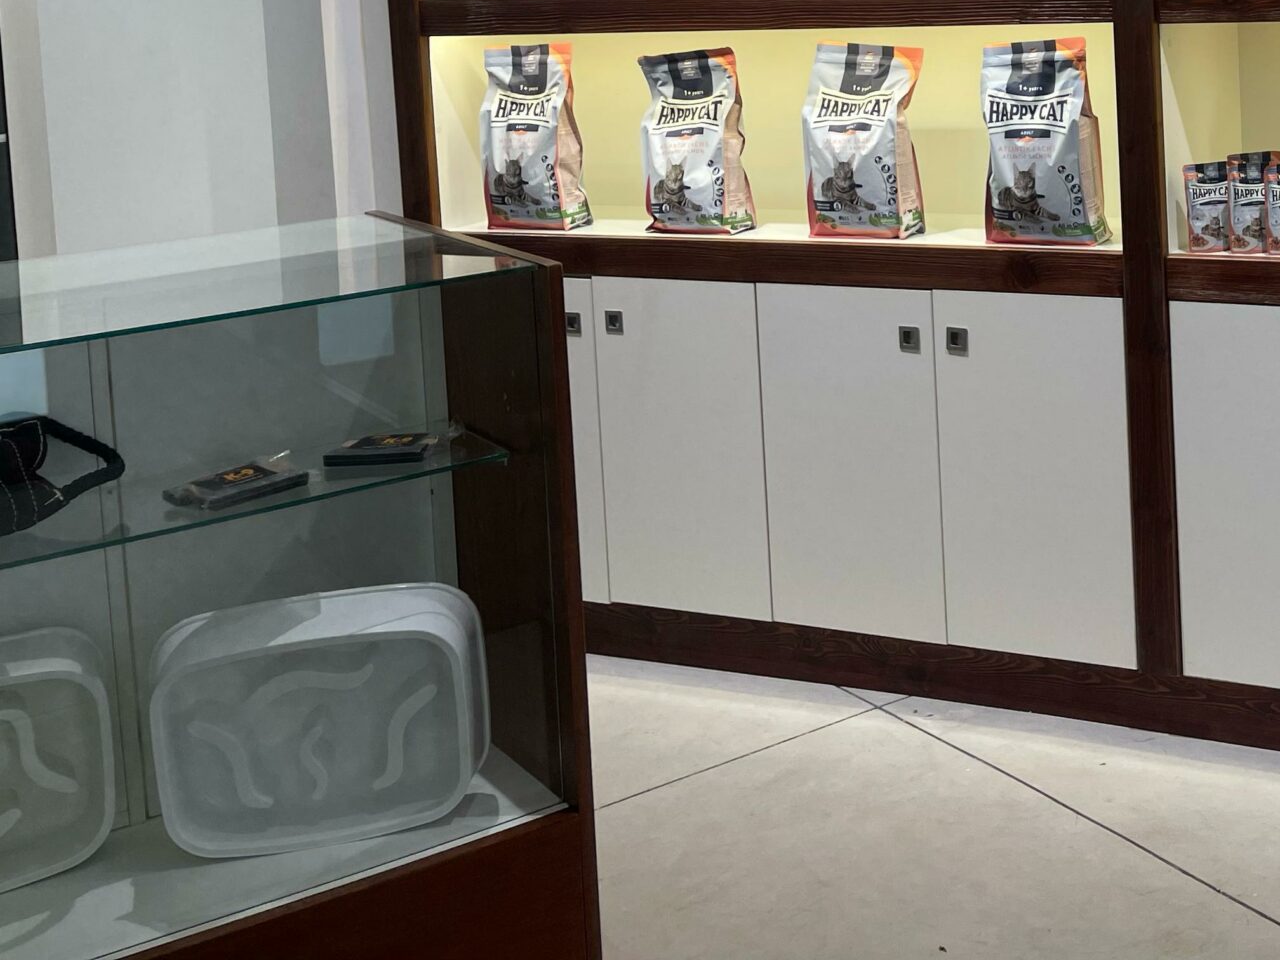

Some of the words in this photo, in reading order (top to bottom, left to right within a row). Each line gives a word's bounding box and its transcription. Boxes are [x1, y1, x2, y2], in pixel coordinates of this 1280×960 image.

[656, 105, 698, 126] HAPPY
[699, 100, 722, 121] CAT
[818, 98, 864, 118] HAPPY
[864, 98, 890, 117] CAT
[988, 100, 1039, 124] HAPPY
[1040, 100, 1068, 122] CAT
[1192, 188, 1217, 200] HAPPY
[1234, 188, 1260, 200] HAPPY
